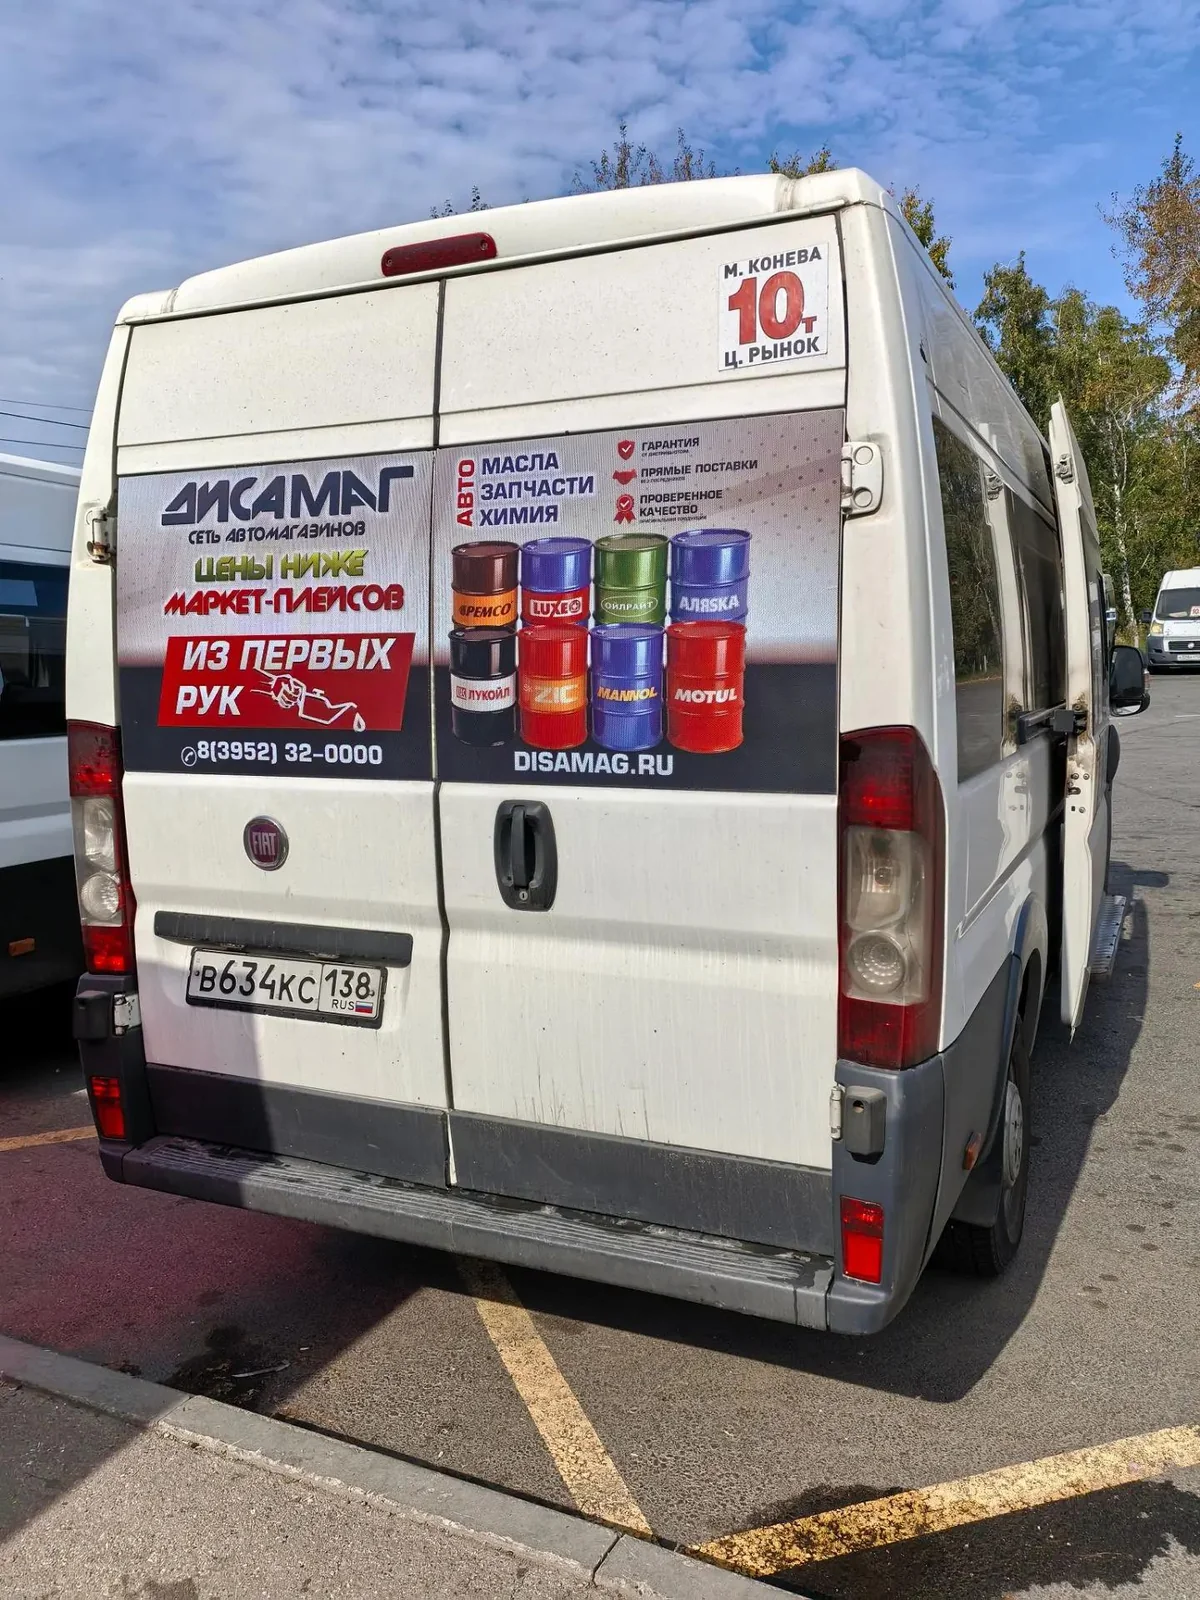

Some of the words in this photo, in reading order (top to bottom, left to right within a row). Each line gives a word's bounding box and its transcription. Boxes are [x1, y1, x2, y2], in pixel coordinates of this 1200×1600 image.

[724, 263, 743, 279] М.
[748, 246, 822, 274] КОНЕВА
[724, 350, 743, 369] Ц.
[748, 336, 820, 363] РЫНОК
[641, 437, 700, 451] ГАРАНТИЯ
[481, 452, 559, 475] МАСЛА
[641, 465, 691, 478] ПРЯМЫЕ
[695, 460, 758, 473] ПОСТАВКИ
[161, 465, 414, 526] ДИСАМАГ
[456, 459, 475, 527] АВТО
[480, 475, 594, 501] ЗАПЧАСТИ
[640, 490, 723, 504] ПРОВЕРЕННОЕ
[479, 504, 559, 527] ХИМИЯ
[639, 505, 698, 517] КАЧЕСТВО
[188, 527, 221, 545] СЕТЬ
[225, 521, 366, 543] АВТОМАГАЗИНОВ
[194, 553, 273, 583] ЦЕНЫ
[280, 549, 369, 580] НИЖЕ
[182, 641, 230, 671] ИЗ
[239, 637, 396, 671] ПЕРВЫХ
[175, 685, 244, 716] РУК
[468, 686, 510, 701] ЛУКОЙЛ
[535, 684, 579, 704] ZIC
[597, 686, 658, 702] MANNOL
[674, 687, 737, 703] MOTUL
[197, 741, 278, 765] 8(3952)
[285, 743, 383, 765] 32-0000
[514, 750, 674, 776] DISAMAG.RU
[252, 831, 277, 856] FIAT
[324, 969, 372, 999] 138
[331, 999, 355, 1011] RUS
